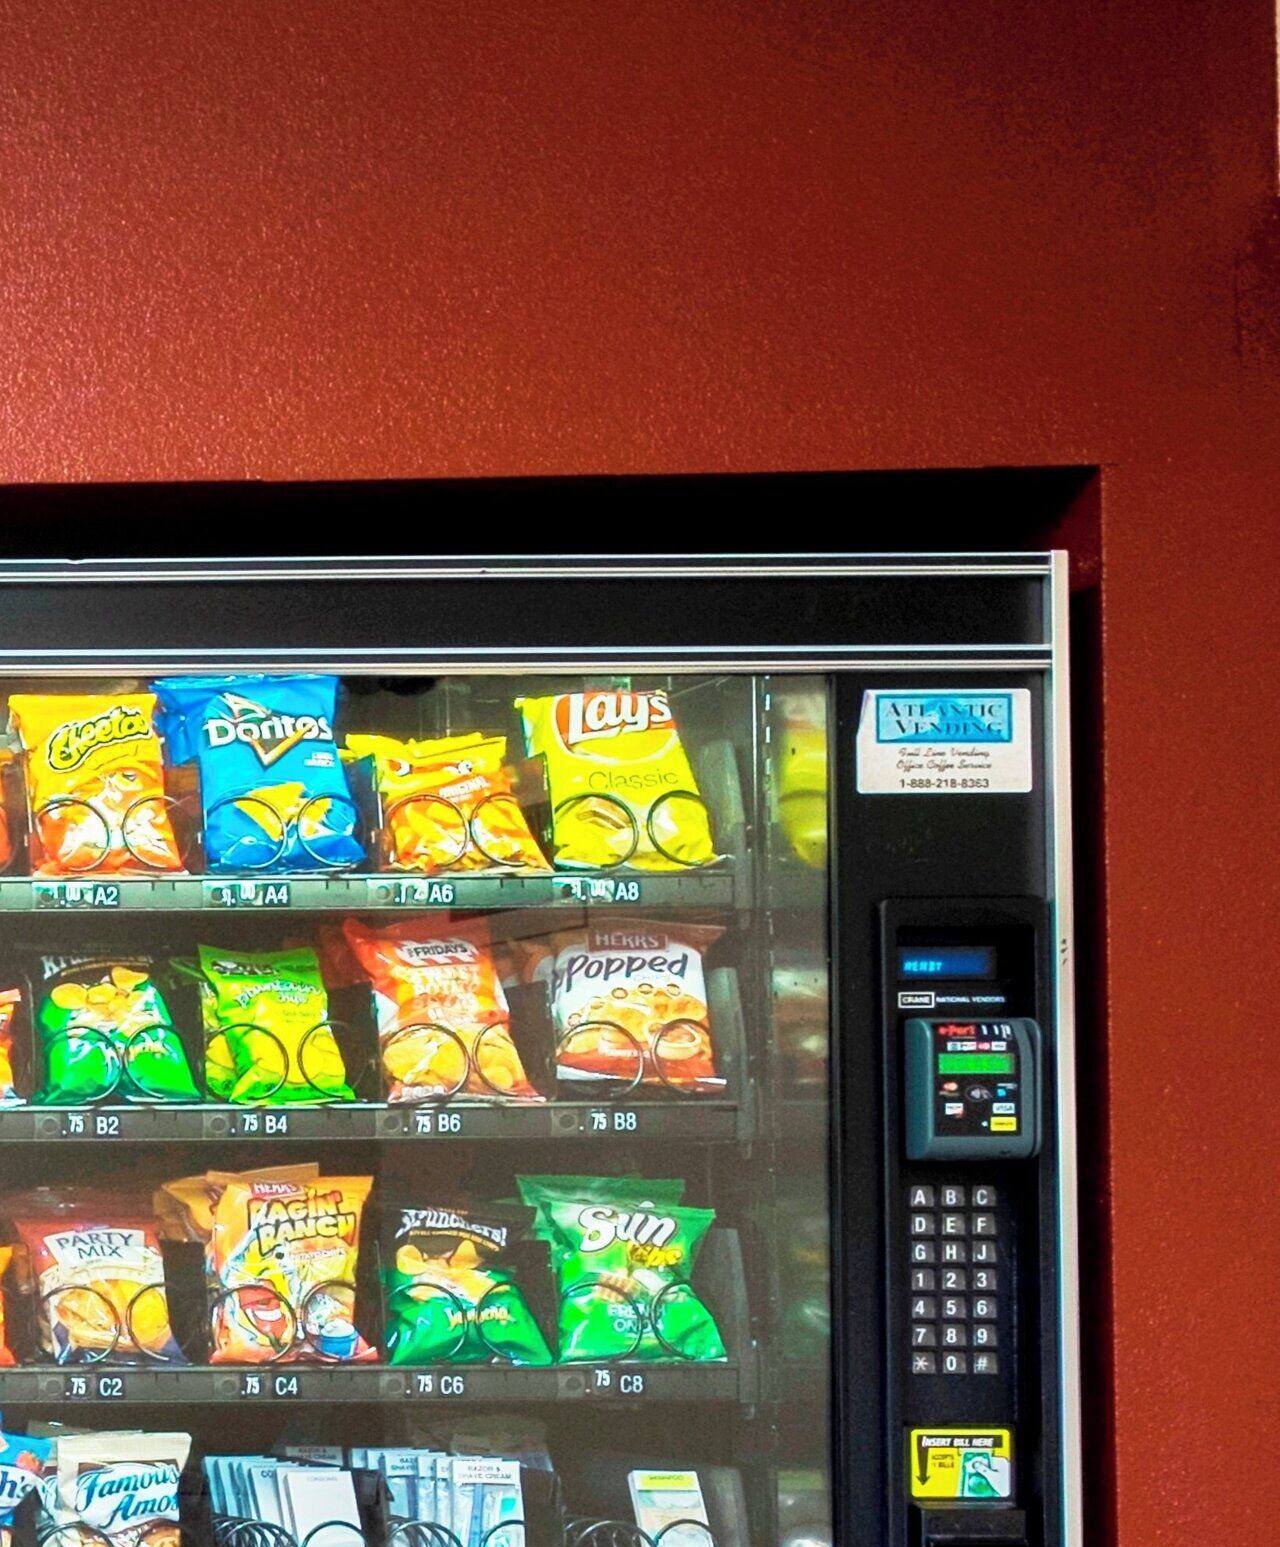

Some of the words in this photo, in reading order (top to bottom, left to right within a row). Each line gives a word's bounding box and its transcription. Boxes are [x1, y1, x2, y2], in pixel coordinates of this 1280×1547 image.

[886, 702, 1003, 718] ATLANTIC
[206, 715, 334, 748] Doritos
[896, 719, 1003, 735] VENDING
[588, 769, 680, 791] Classic
[898, 777, 990, 789] 1-888-218-8363
[94, 886, 119, 907] A2
[265, 884, 289, 904] A4
[429, 883, 454, 903] A6
[615, 882, 640, 902] A8
[566, 952, 689, 993] Popped
[902, 996, 932, 1004] CRANE
[97, 1116, 120, 1135] B2
[266, 1115, 288, 1134] B4
[438, 1113, 461, 1132] B6
[614, 1113, 637, 1131] B8
[914, 1189, 926, 1205] A
[945, 1189, 957, 1205] B
[976, 1189, 988, 1205] C
[578, 1205, 678, 1254] Sun
[914, 1217, 926, 1232] D
[945, 1217, 957, 1232] E
[976, 1217, 988, 1232] F
[55, 1230, 136, 1249] PARTY
[77, 1244, 124, 1261] MIX
[914, 1244, 926, 1260] G
[945, 1244, 957, 1260] H
[976, 1244, 988, 1260] J
[914, 1272, 926, 1288] 1
[945, 1272, 957, 1288] 2
[976, 1272, 988, 1288] 3
[914, 1300, 926, 1315] 4
[945, 1300, 957, 1315] 5
[976, 1300, 988, 1315] 6
[914, 1328, 926, 1343] 7
[945, 1328, 957, 1343] 8
[976, 1328, 988, 1343] 9
[945, 1356, 957, 1371] 0
[976, 1356, 988, 1371] #
[64, 1377, 86, 1396] .75
[100, 1378, 123, 1397] C2
[240, 1376, 260, 1396] .75
[275, 1377, 298, 1396] C4
[440, 1376, 464, 1395] C6
[620, 1375, 643, 1394] C8
[921, 1435, 953, 1448] INSERT
[953, 1436, 971, 1447] BILL
[972, 1437, 995, 1447] HERE
[76, 1464, 181, 1513] Famous
[110, 1493, 180, 1528] Amos
